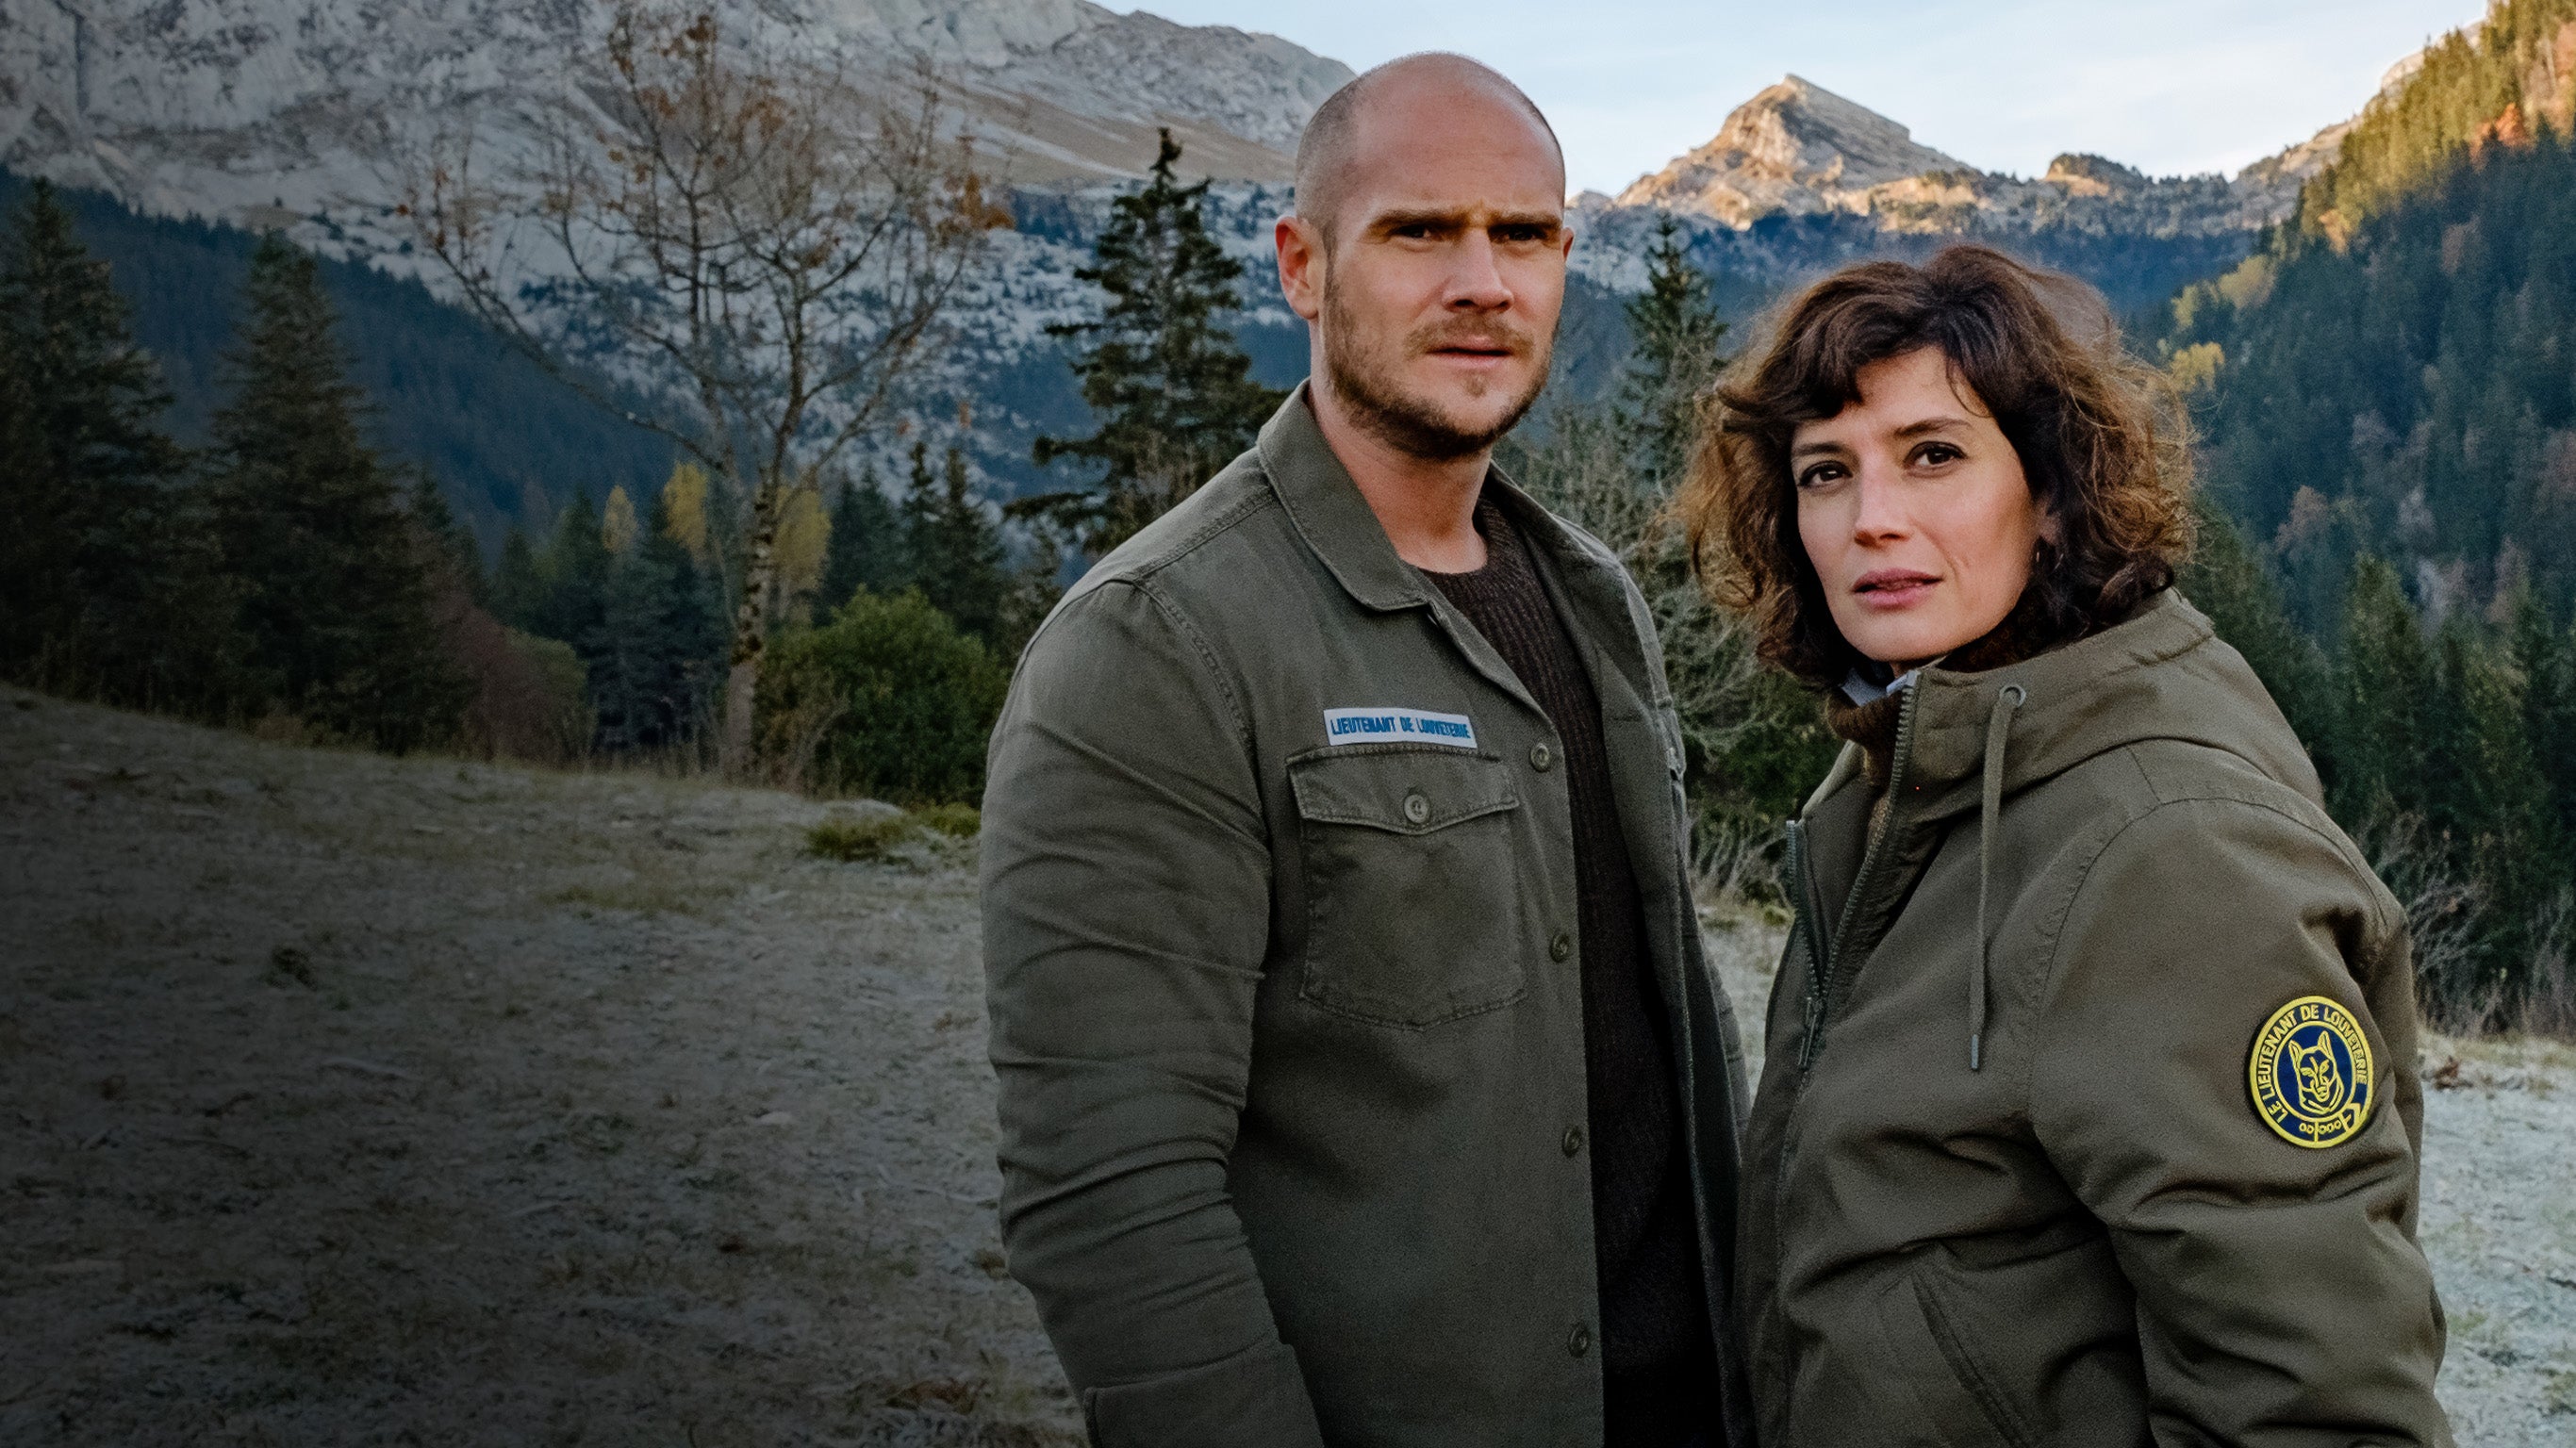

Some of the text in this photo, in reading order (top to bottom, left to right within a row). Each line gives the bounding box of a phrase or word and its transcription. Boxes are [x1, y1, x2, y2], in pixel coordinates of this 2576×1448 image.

[1330, 716, 1396, 735] LIEUTENANT
[1399, 716, 1414, 732] DE
[2257, 1004, 2368, 1123] LE LIEUTENANT DE LOUVETERIE
